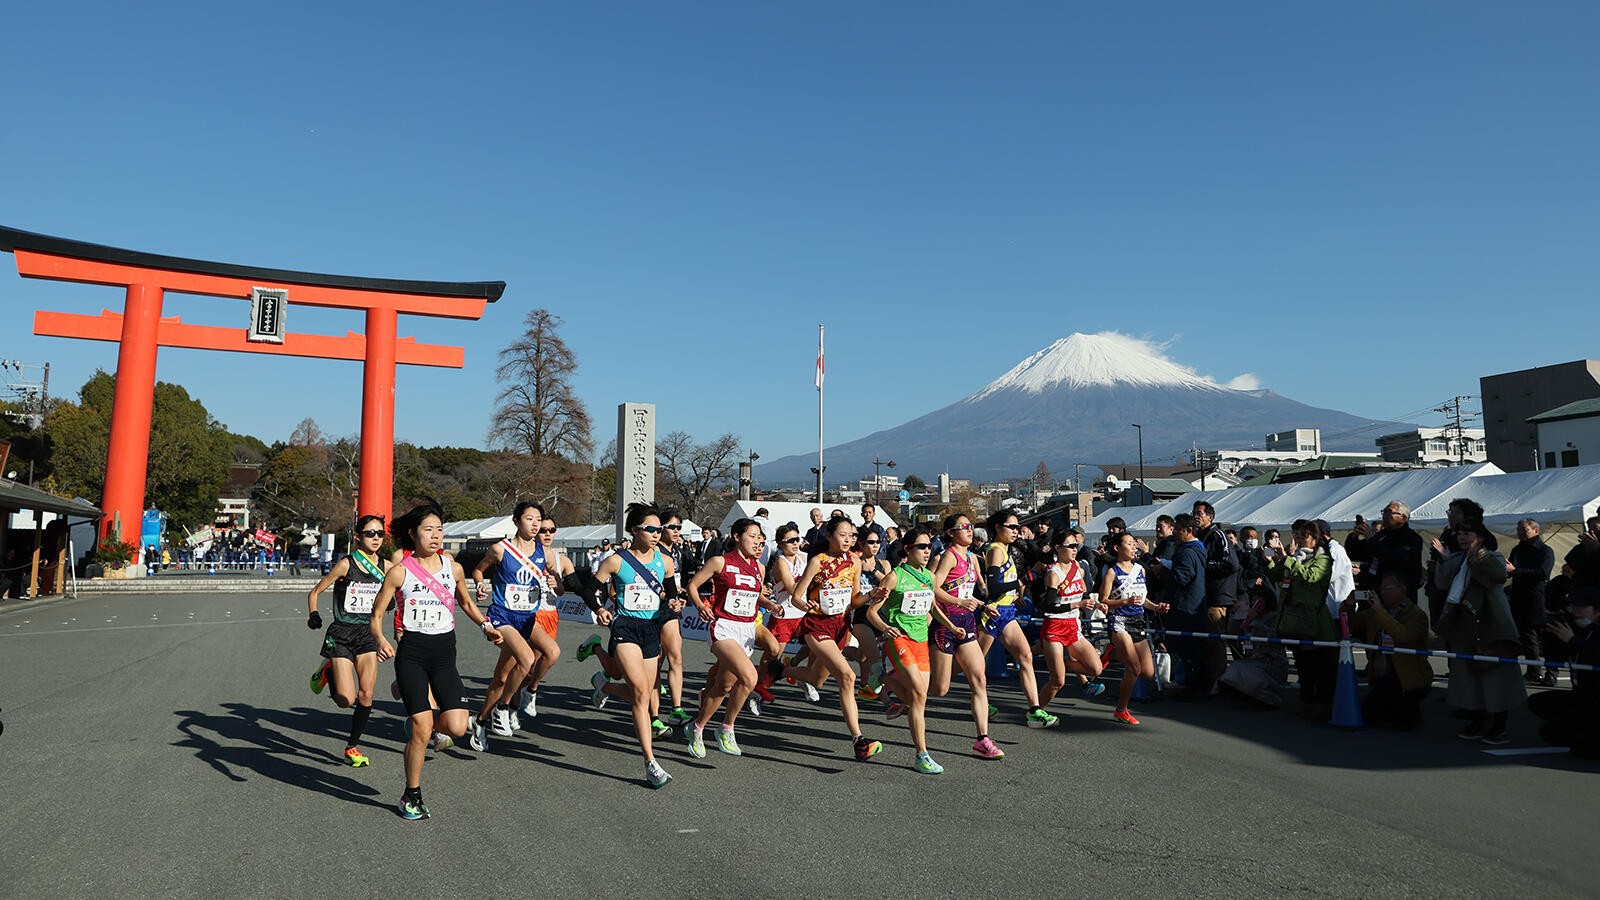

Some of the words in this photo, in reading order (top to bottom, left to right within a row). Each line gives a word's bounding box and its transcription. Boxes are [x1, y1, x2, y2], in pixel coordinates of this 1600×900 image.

[633, 592, 653, 603] 7-1
[829, 588, 851, 596] SUZUKI
[732, 598, 751, 609] 5-1
[828, 597, 845, 608] 3-1
[909, 599, 927, 610] 2-1
[412, 608, 442, 621] 11-1
